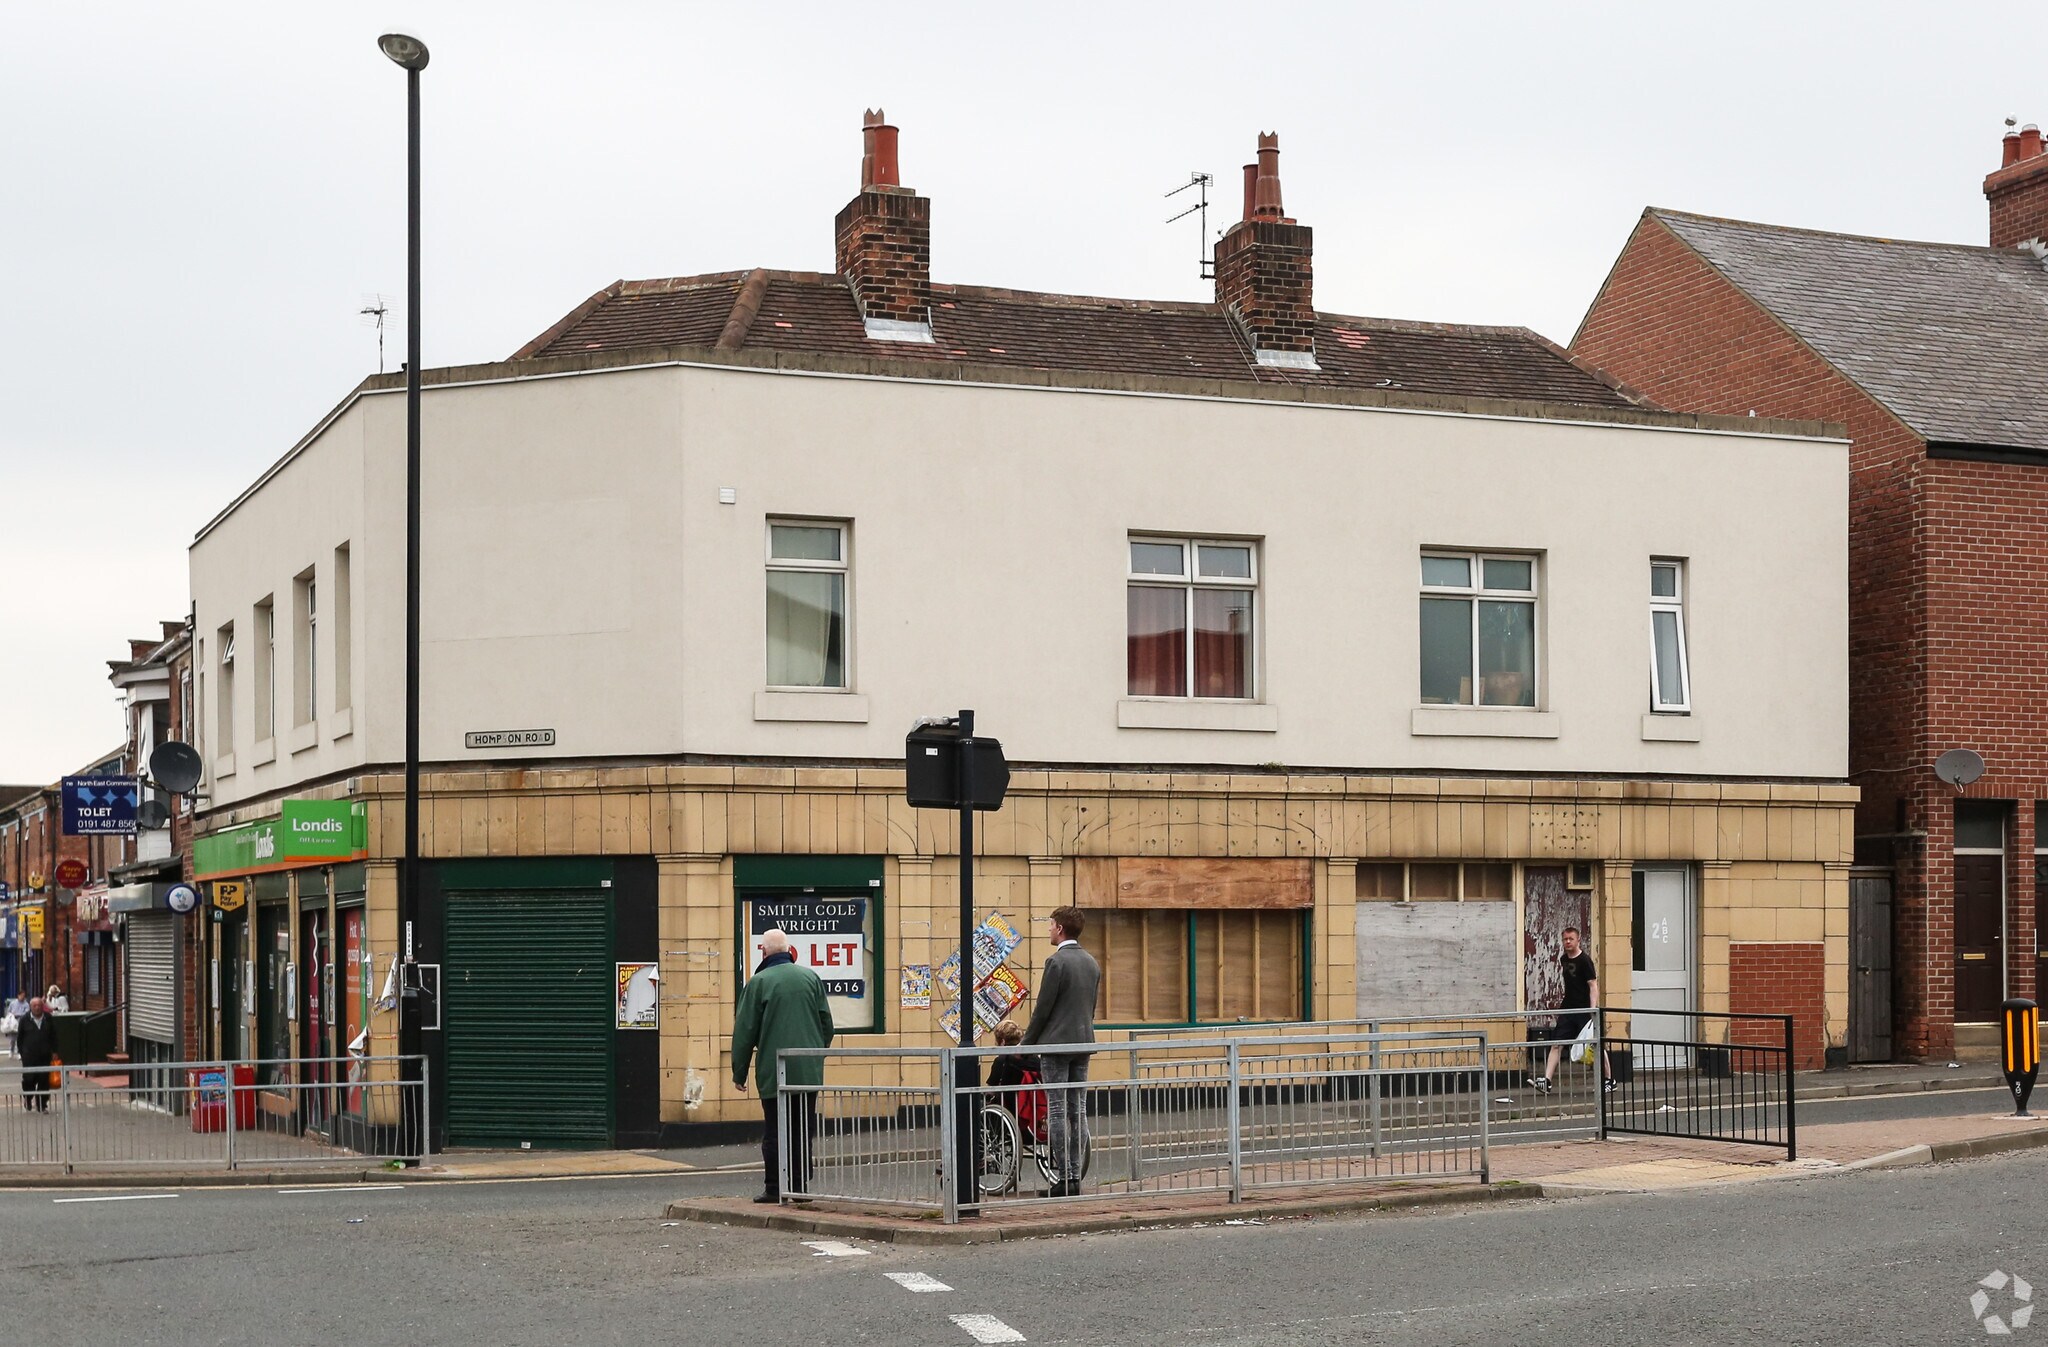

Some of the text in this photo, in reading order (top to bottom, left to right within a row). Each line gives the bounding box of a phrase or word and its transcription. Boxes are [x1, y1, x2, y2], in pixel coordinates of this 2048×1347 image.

[77, 807, 112, 817] TO LET
[77, 820, 98, 828] 0191
[100, 820, 116, 828] 487
[292, 817, 343, 832] Londis
[255, 827, 275, 859] Londis
[758, 904, 857, 916] SMITH COLE
[776, 920, 840, 932] WRIGHT
[810, 943, 858, 967] LET
[992, 967, 1019, 993] CIRCUS
[827, 982, 859, 992] 1616
